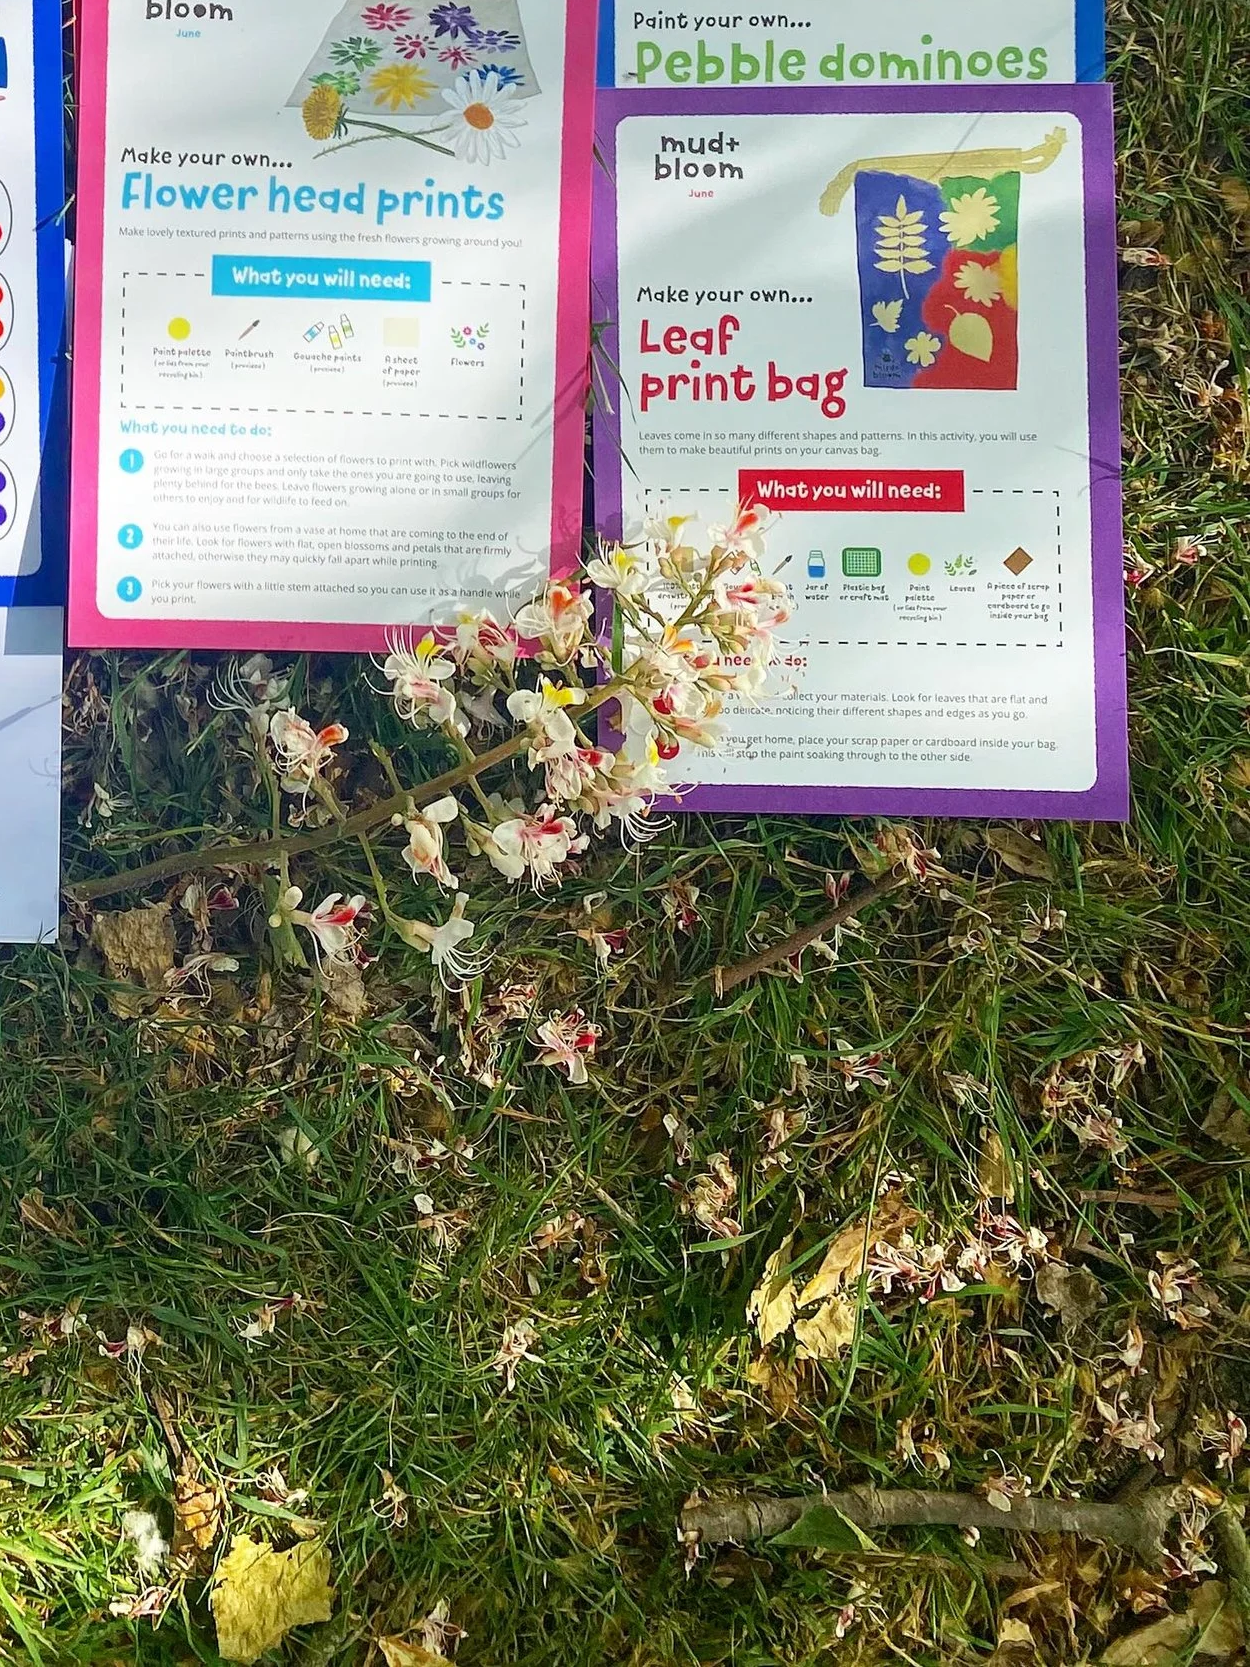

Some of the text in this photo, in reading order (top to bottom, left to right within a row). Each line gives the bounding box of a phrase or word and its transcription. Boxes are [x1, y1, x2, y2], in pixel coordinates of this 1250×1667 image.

[633, 10, 811, 31] Paint your own...
[175, 28, 201, 38] June
[637, 34, 1048, 84] Pebble dominoes
[660, 131, 740, 154] mud+
[120, 146, 292, 168] Make your own...
[654, 153, 744, 180] bloom
[121, 171, 505, 225] Flower head prints
[687, 188, 714, 198] June
[231, 265, 411, 289] What you will need:
[636, 285, 813, 305] Make your own...
[639, 314, 740, 355] Leaf
[639, 359, 849, 418] print bag
[638, 444, 882, 457] them to make beautiful prints on your canvas bag.
[756, 479, 941, 500] What you will need:
